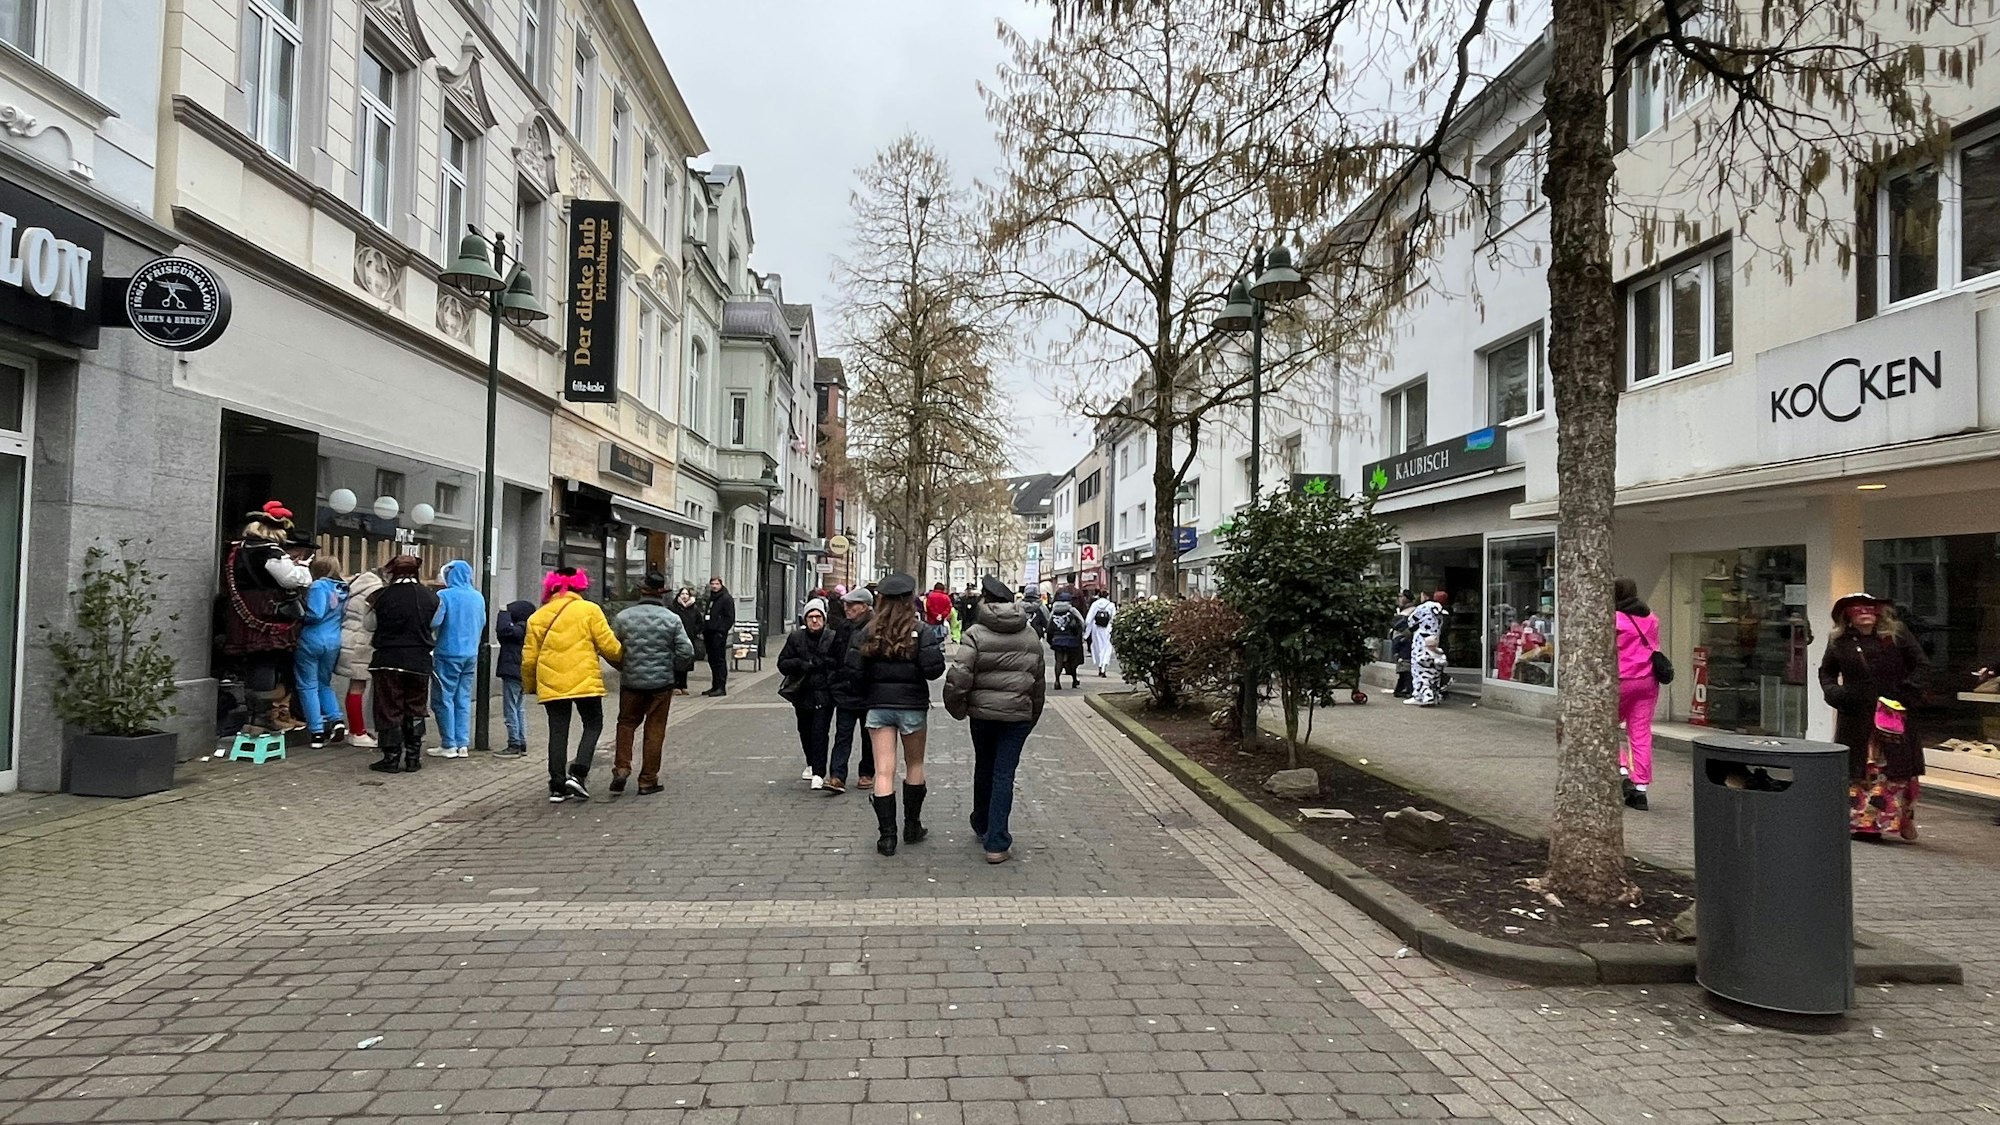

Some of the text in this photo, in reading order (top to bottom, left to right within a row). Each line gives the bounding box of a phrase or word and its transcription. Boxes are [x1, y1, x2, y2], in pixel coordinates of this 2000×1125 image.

[133, 265, 212, 311] ISSO FRISEURSALON
[595, 219, 613, 301] Frischburger
[138, 314, 206, 325] DAMEN & HERREN
[573, 217, 597, 366] Der dicke Bub
[1770, 350, 1942, 423] KOCKEN
[1395, 449, 1449, 480] KAUBISCH
